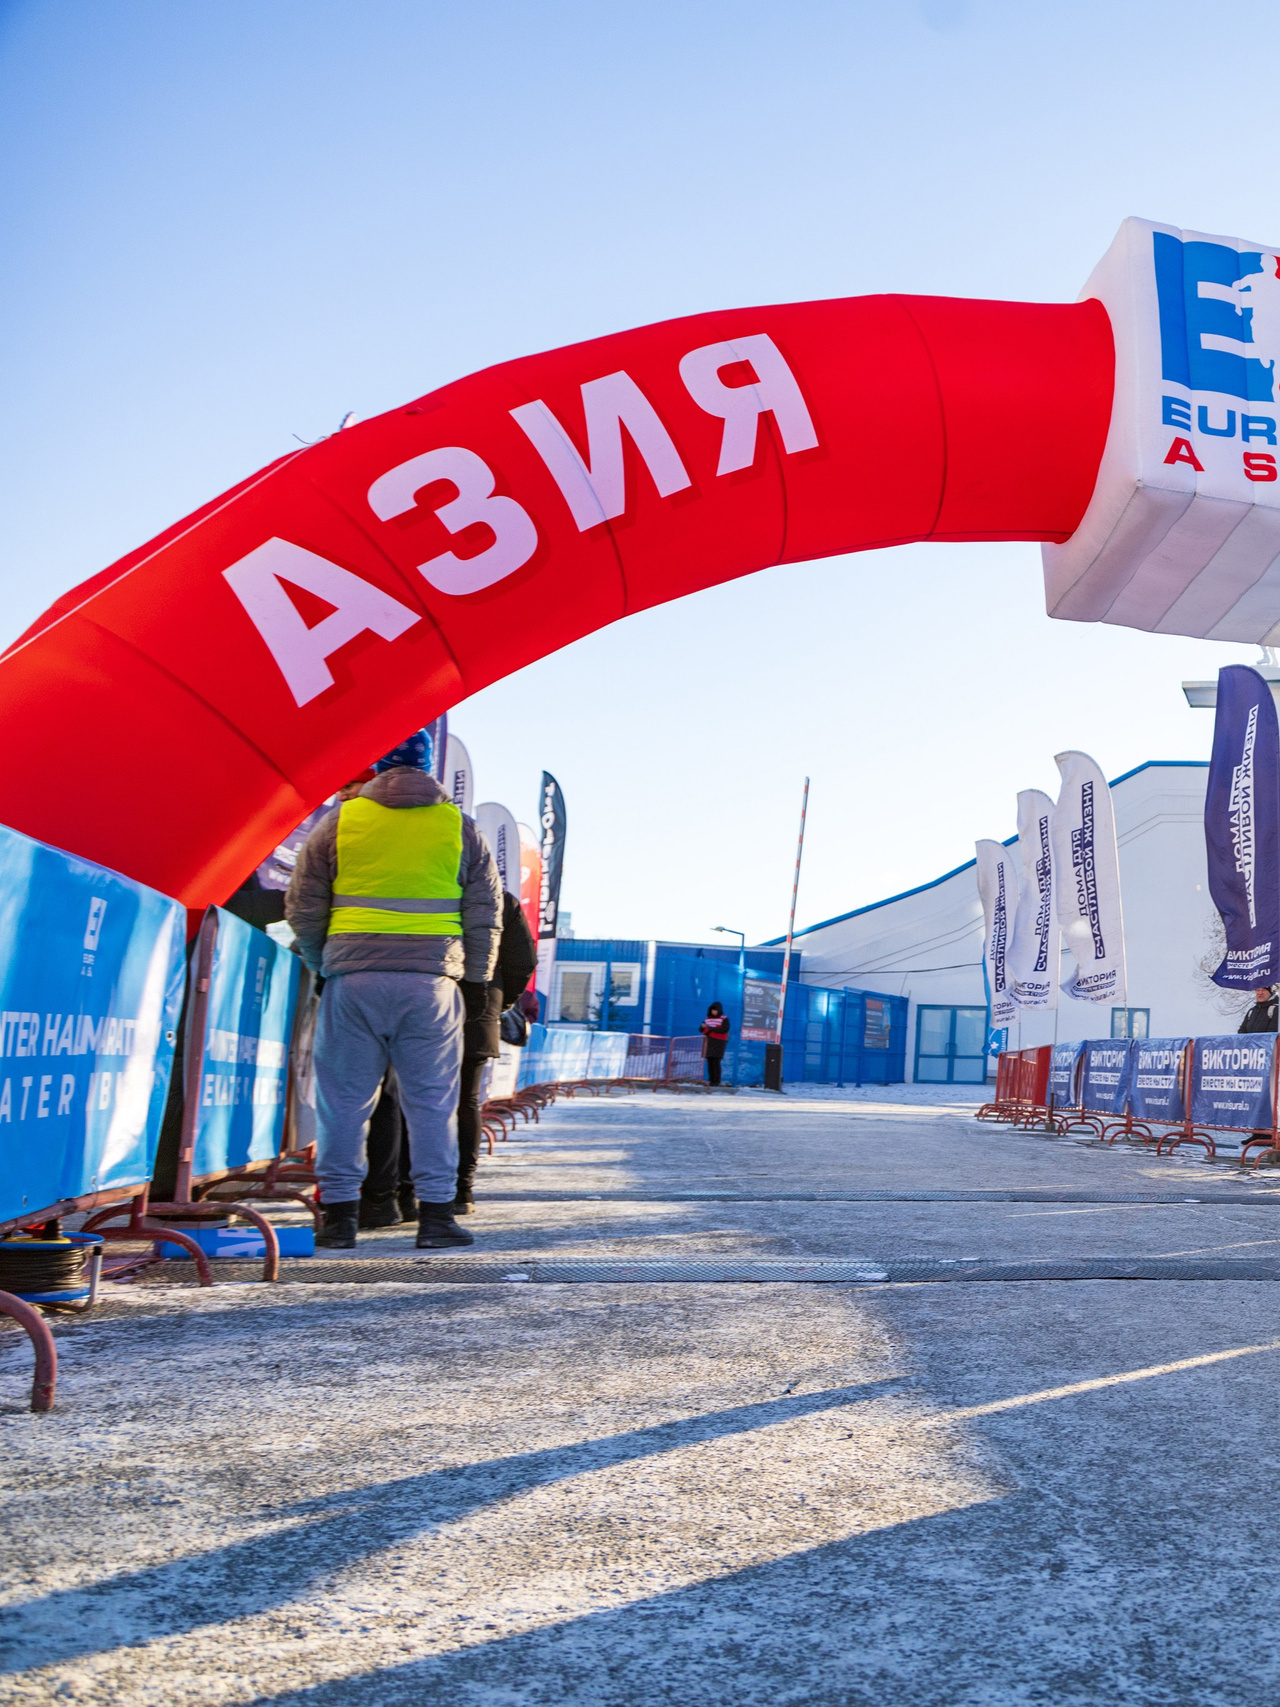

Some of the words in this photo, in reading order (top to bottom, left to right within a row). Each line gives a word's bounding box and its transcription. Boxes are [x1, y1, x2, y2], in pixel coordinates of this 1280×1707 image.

[221, 333, 819, 708] АЗИЯ
[1083, 782, 1093, 844] ЖИЗНИ
[1072, 830, 1084, 865] ДЛЯ
[1075, 865, 1089, 917] ДОМА
[1082, 846, 1104, 958] СЧАСТЛИВОЙ
[1202, 1048, 1266, 1070] ВИКТОРИЯ
